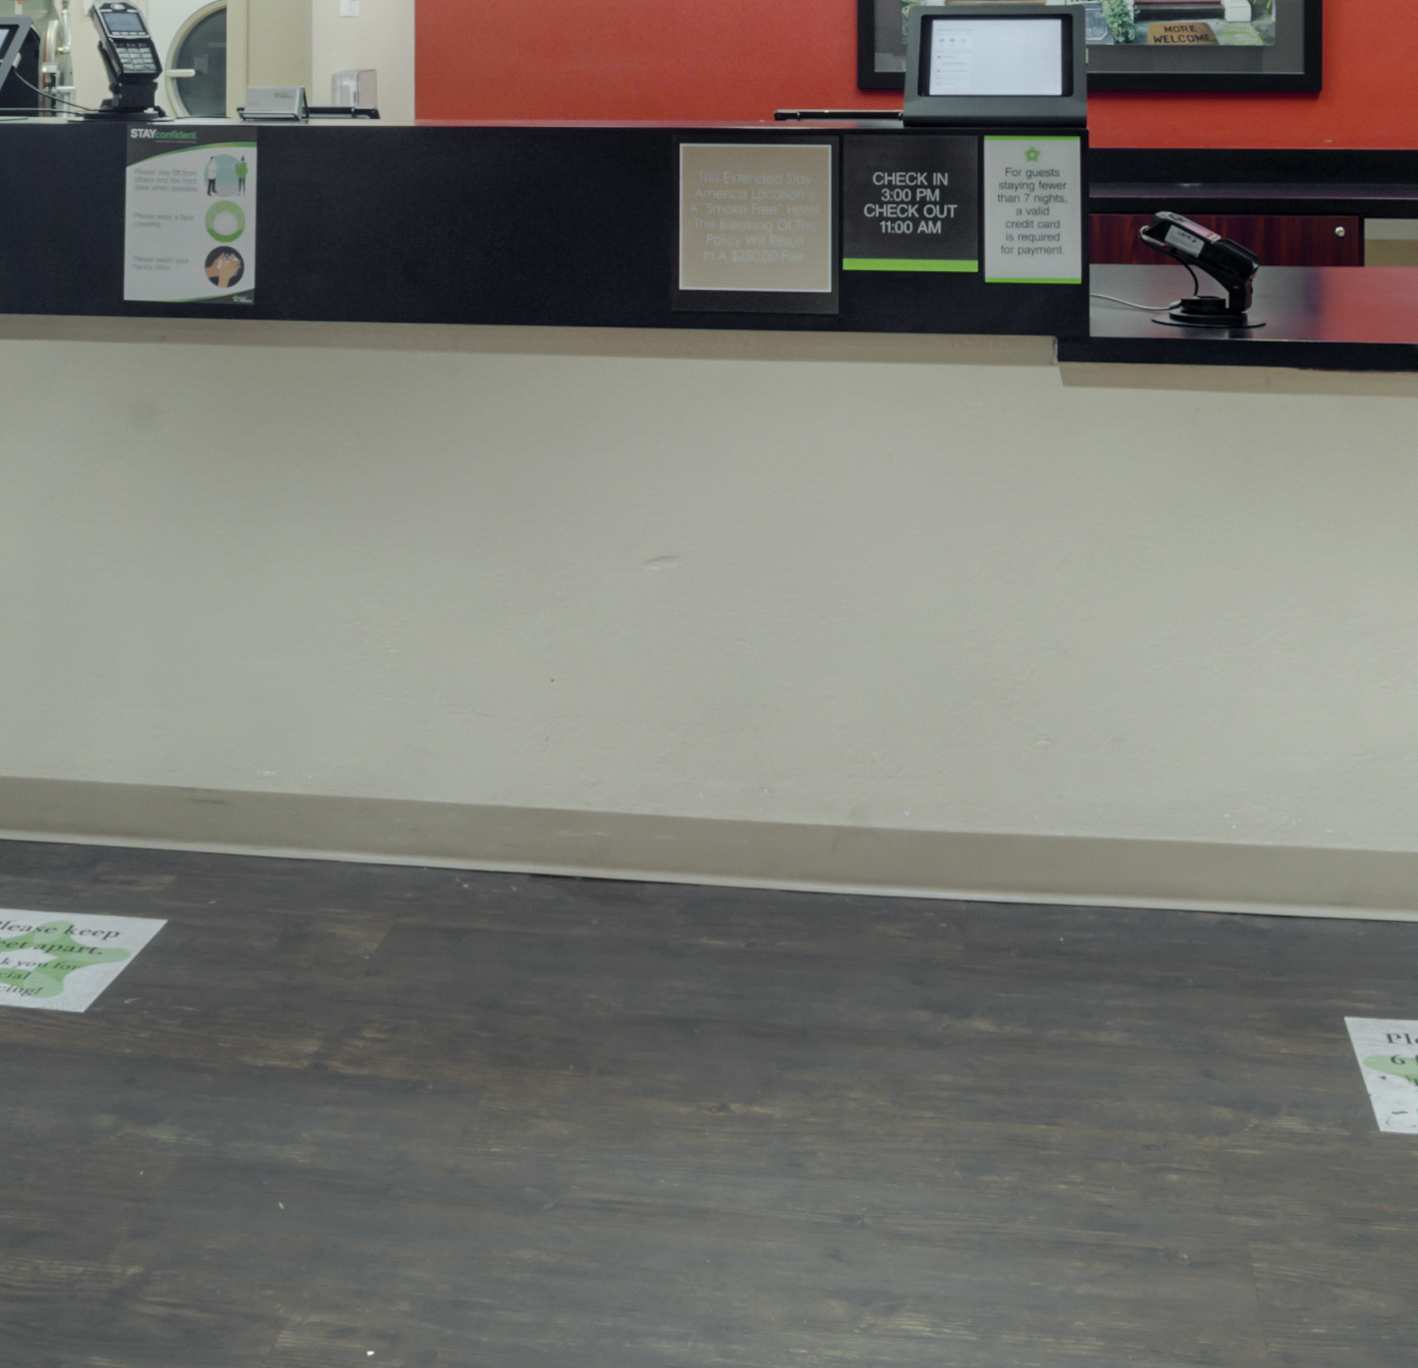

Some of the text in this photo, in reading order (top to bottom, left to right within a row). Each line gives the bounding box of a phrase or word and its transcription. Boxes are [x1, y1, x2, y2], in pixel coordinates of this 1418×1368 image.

[1154, 34, 1213, 43] WELCOME
[699, 172, 812, 186] This Extended Stay
[873, 172, 948, 186] CHECK IN
[1005, 167, 1060, 179] For guests
[999, 181, 1066, 191] staying fewer
[695, 188, 747, 200] America
[752, 189, 804, 200] Location
[881, 189, 939, 201] 3:00 PM
[997, 193, 1020, 203] than
[1024, 194, 1029, 203] 7
[690, 203, 698, 212] A
[864, 204, 957, 218] CHECK OUT
[1016, 206, 1049, 216] a valid
[695, 218, 817, 232] The Breaking Of This
[880, 221, 941, 233] 11:00 AM
[1006, 219, 1060, 229] credit card
[706, 234, 804, 247] Policy Will Result
[1006, 233, 1060, 244] is required
[703, 250, 714, 261] In
[718, 251, 727, 261] A
[731, 250, 778, 262] $250.00
[1001, 245, 1064, 257] for payment.
[65, 924, 120, 941] keep
[34, 943, 103, 956] apart.
[14, 957, 49, 970] you
[53, 960, 81, 971] for
[1391, 1055, 1406, 1066] 6
